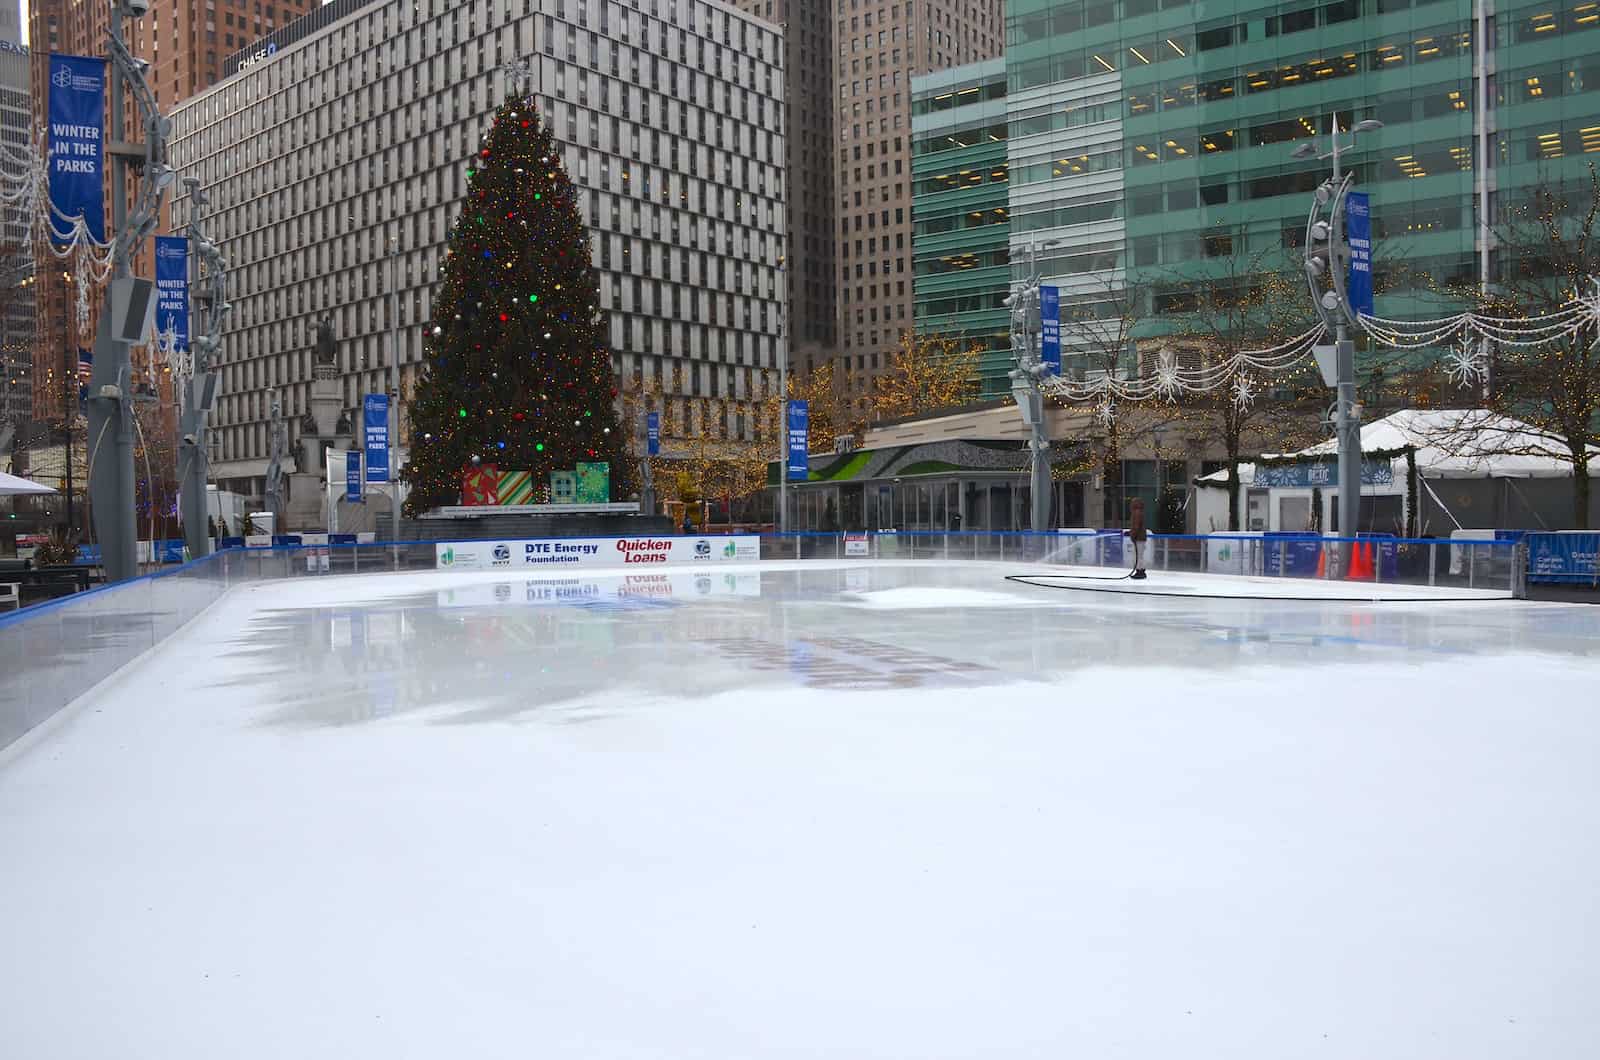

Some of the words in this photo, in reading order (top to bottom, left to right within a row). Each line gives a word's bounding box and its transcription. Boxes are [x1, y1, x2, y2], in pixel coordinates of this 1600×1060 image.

[238, 48, 267, 72] CHASE
[53, 123, 99, 139] WINTER
[55, 141, 70, 155] IN
[73, 142, 97, 157] THE
[57, 159, 96, 173] PARKS
[1350, 238, 1369, 249] WINTER
[1351, 250, 1358, 259] IN
[1359, 250, 1369, 260] THE
[1352, 262, 1369, 272] PARKS
[157, 279, 185, 289] WINTER
[159, 290, 169, 299] IN
[170, 290, 184, 299] THE
[160, 301, 183, 310] PARKS
[525, 543, 551, 554] DTE
[554, 543, 599, 555] Energy
[616, 538, 673, 553] Quicken
[526, 554, 580, 563] Foundation
[624, 551, 667, 563] Loans
